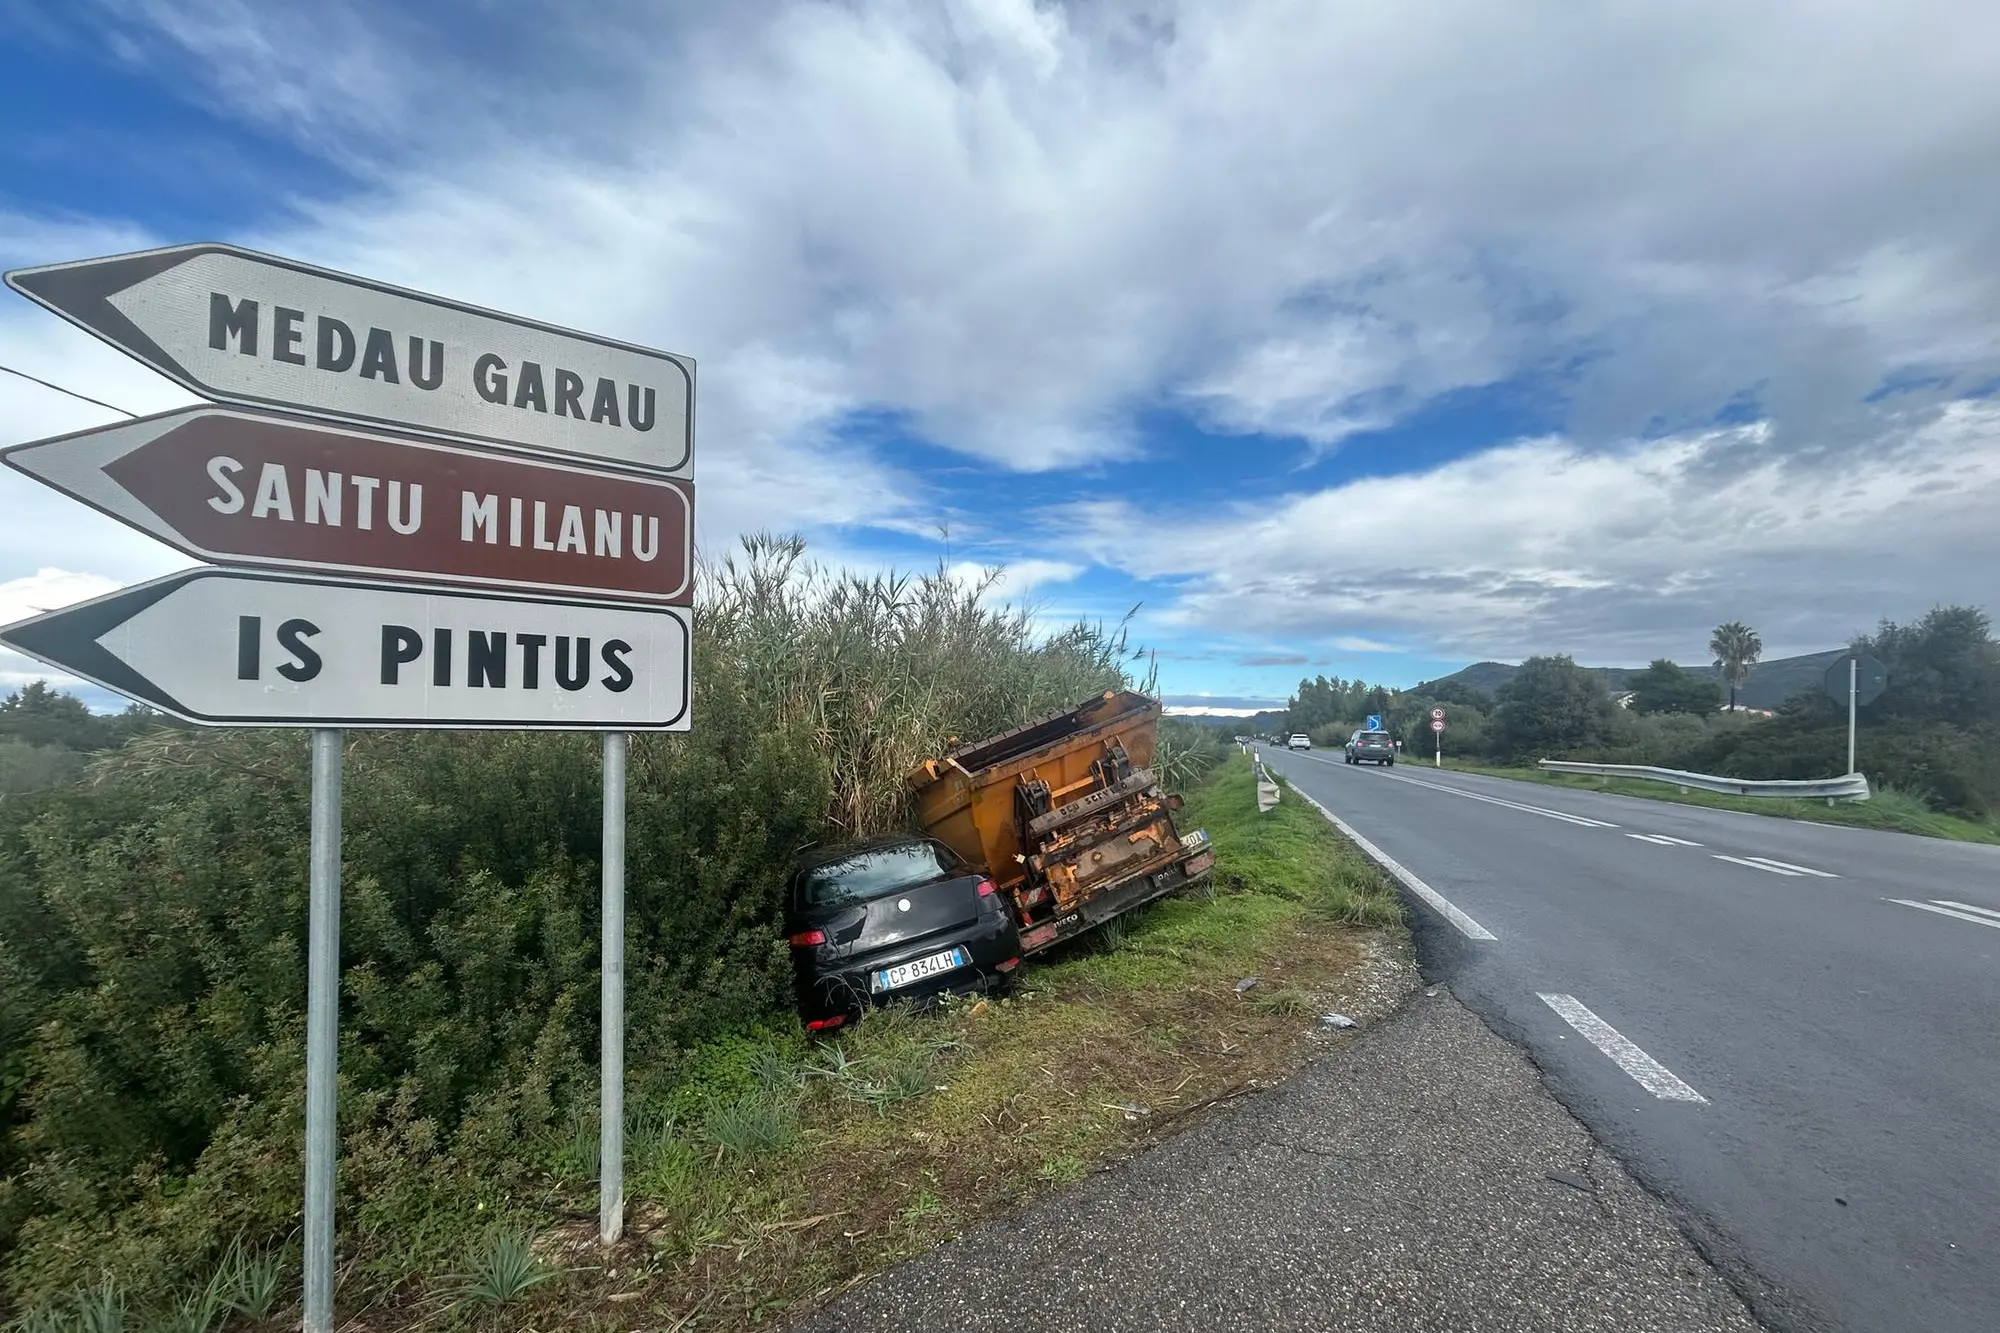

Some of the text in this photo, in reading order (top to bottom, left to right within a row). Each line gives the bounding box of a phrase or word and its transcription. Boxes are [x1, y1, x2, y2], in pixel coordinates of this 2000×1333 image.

[208, 291, 656, 432] MEDAU GARAU
[206, 456, 659, 562] SANTU MILANU
[237, 615, 634, 693] IS PINTUS
[1053, 914, 1078, 928] IVECO
[889, 951, 955, 985] CP 834LH
